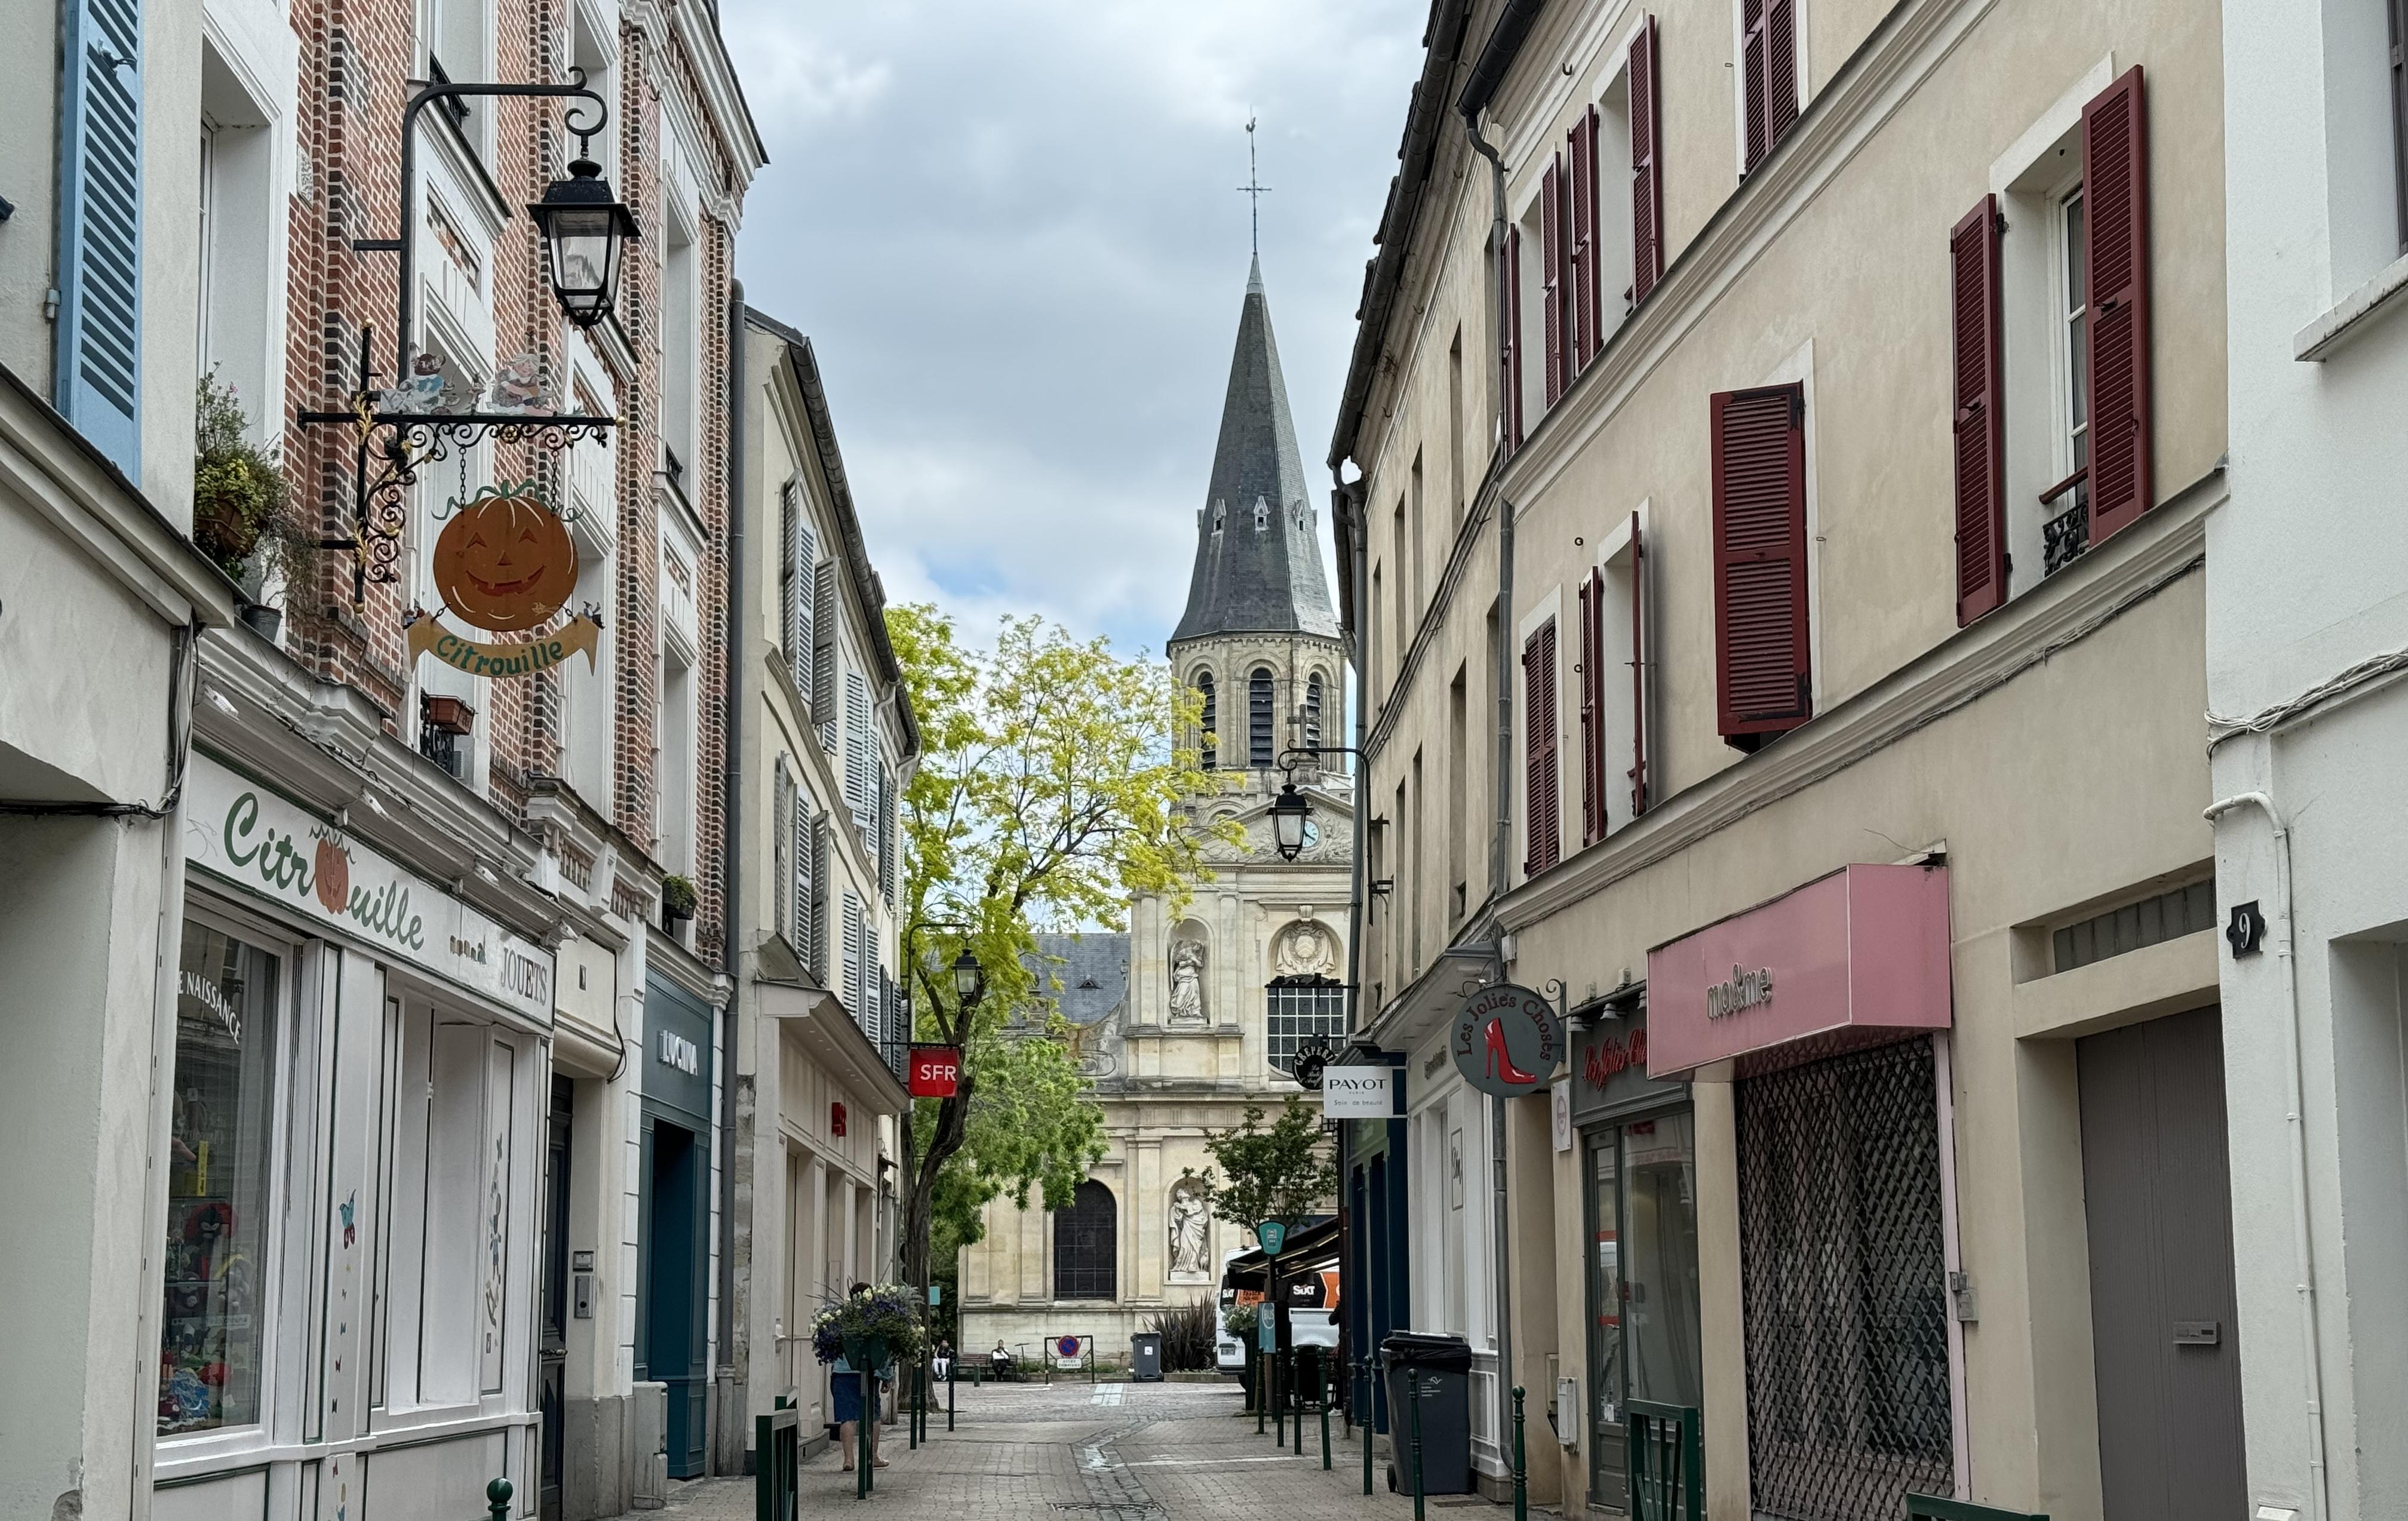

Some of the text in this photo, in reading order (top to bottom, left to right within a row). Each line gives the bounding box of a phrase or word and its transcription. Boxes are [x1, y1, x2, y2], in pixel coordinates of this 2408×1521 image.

[437, 635, 564, 675] Citrouille
[2238, 912, 2250, 949] 9
[500, 947, 547, 1007] JOUETS
[187, 971, 241, 1045] NAISSANCE
[1457, 993, 1553, 1061] Les Jolies Choses
[920, 1064, 957, 1081] SFR
[1329, 1078, 1387, 1090] PAYOT
